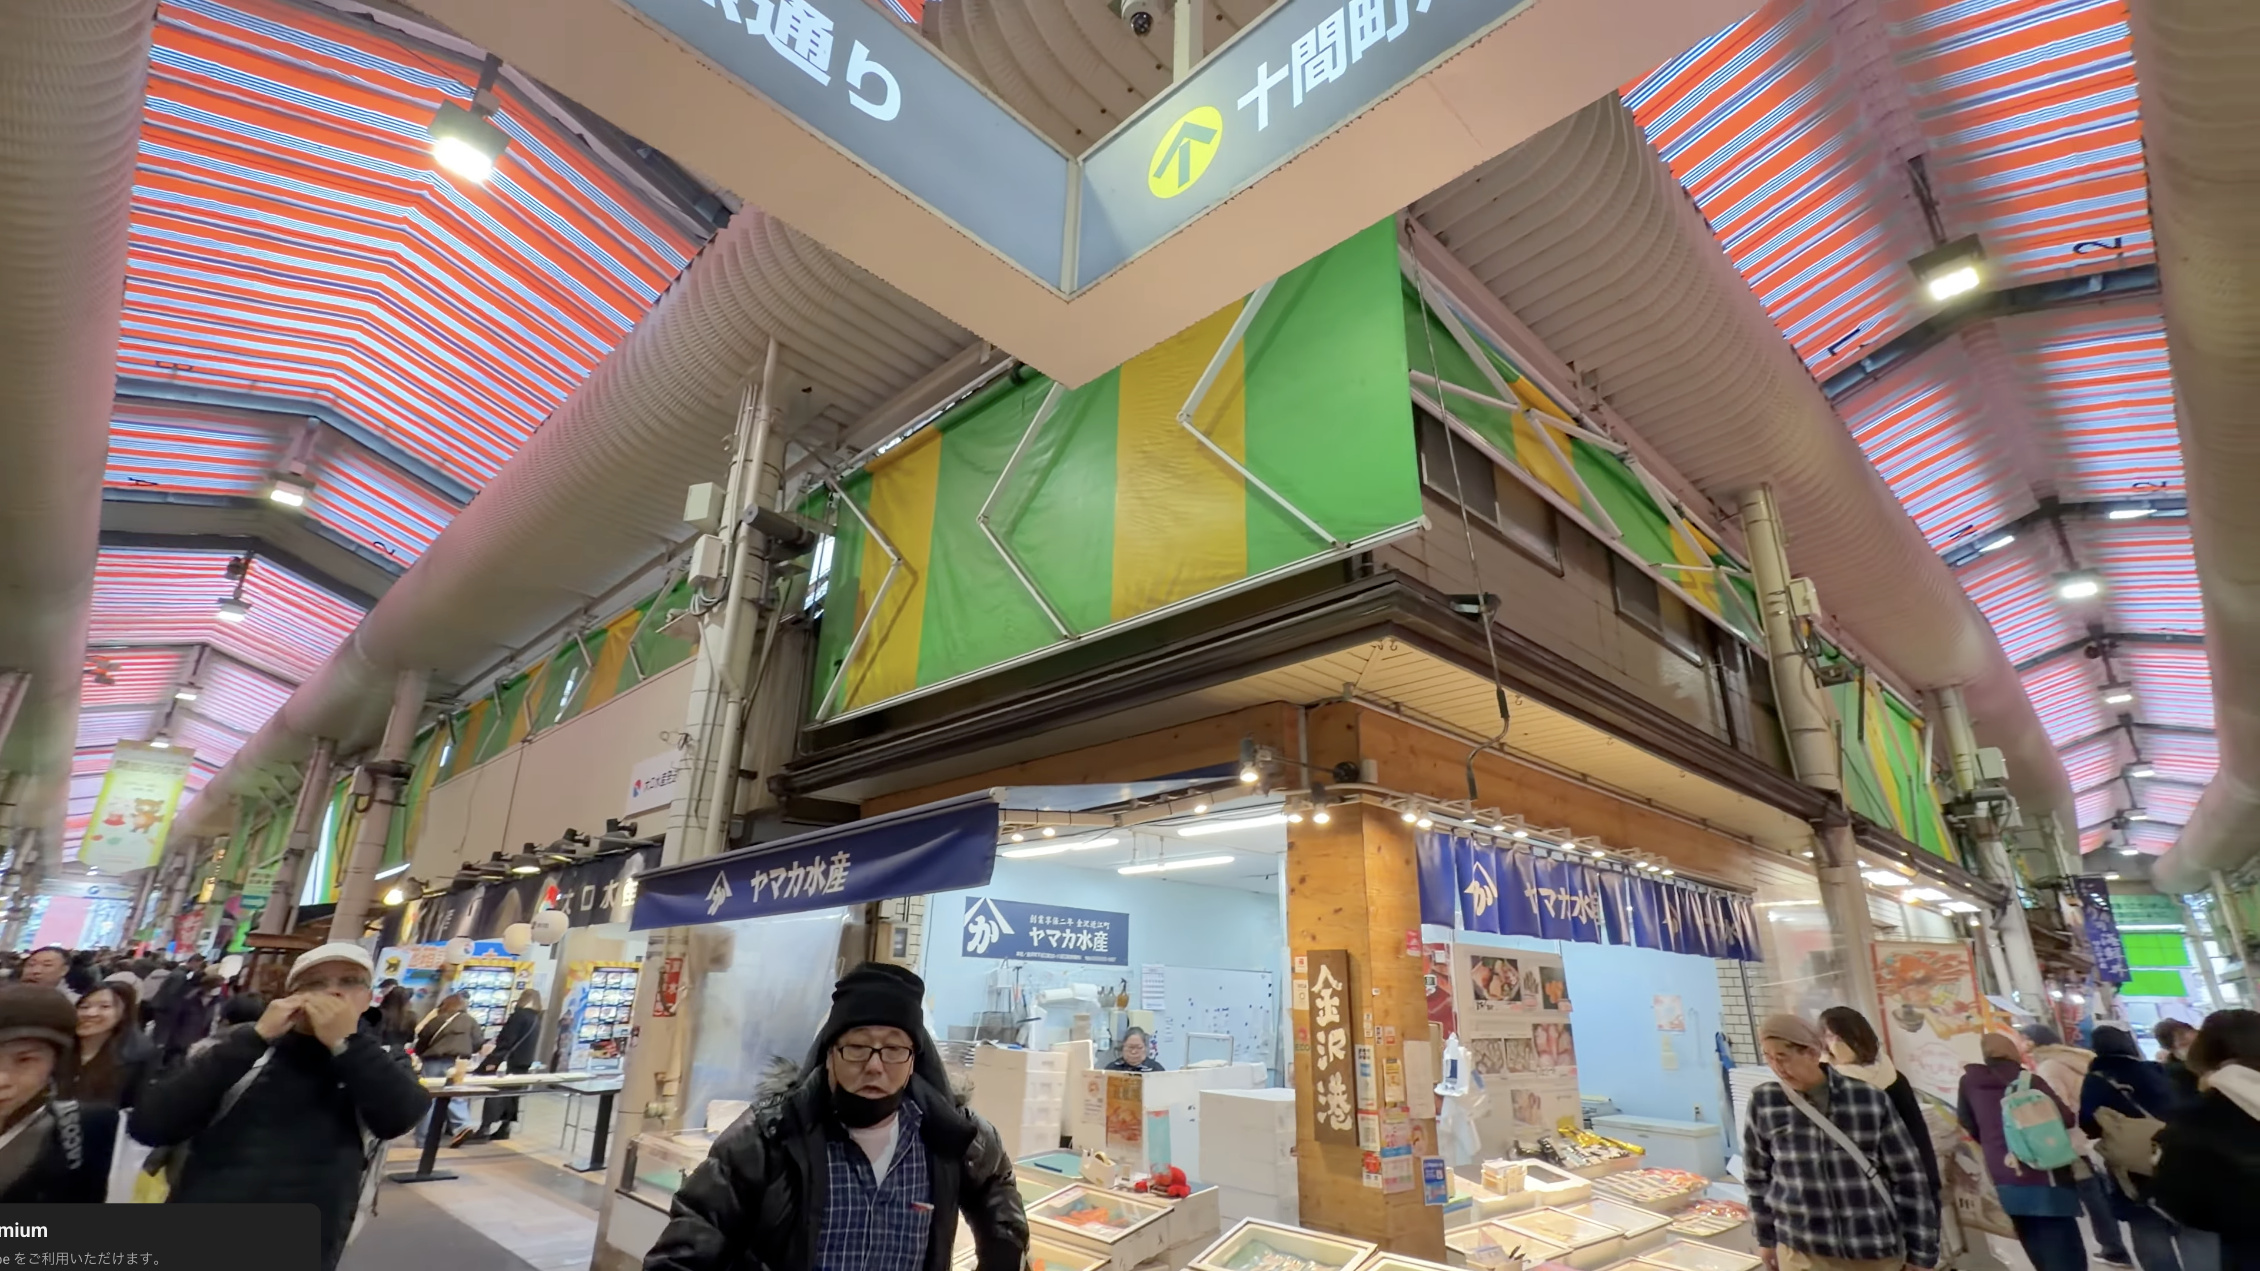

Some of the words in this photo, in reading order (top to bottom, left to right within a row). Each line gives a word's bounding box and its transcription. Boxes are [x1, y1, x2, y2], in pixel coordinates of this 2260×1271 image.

[703, 0, 901, 121] 通り
[1237, 0, 1432, 131] 十間町
[751, 851, 851, 903] ヤマカ水産
[1029, 926, 1109, 952] ヤマカ水産
[1311, 964, 1353, 1131] 金沢港
